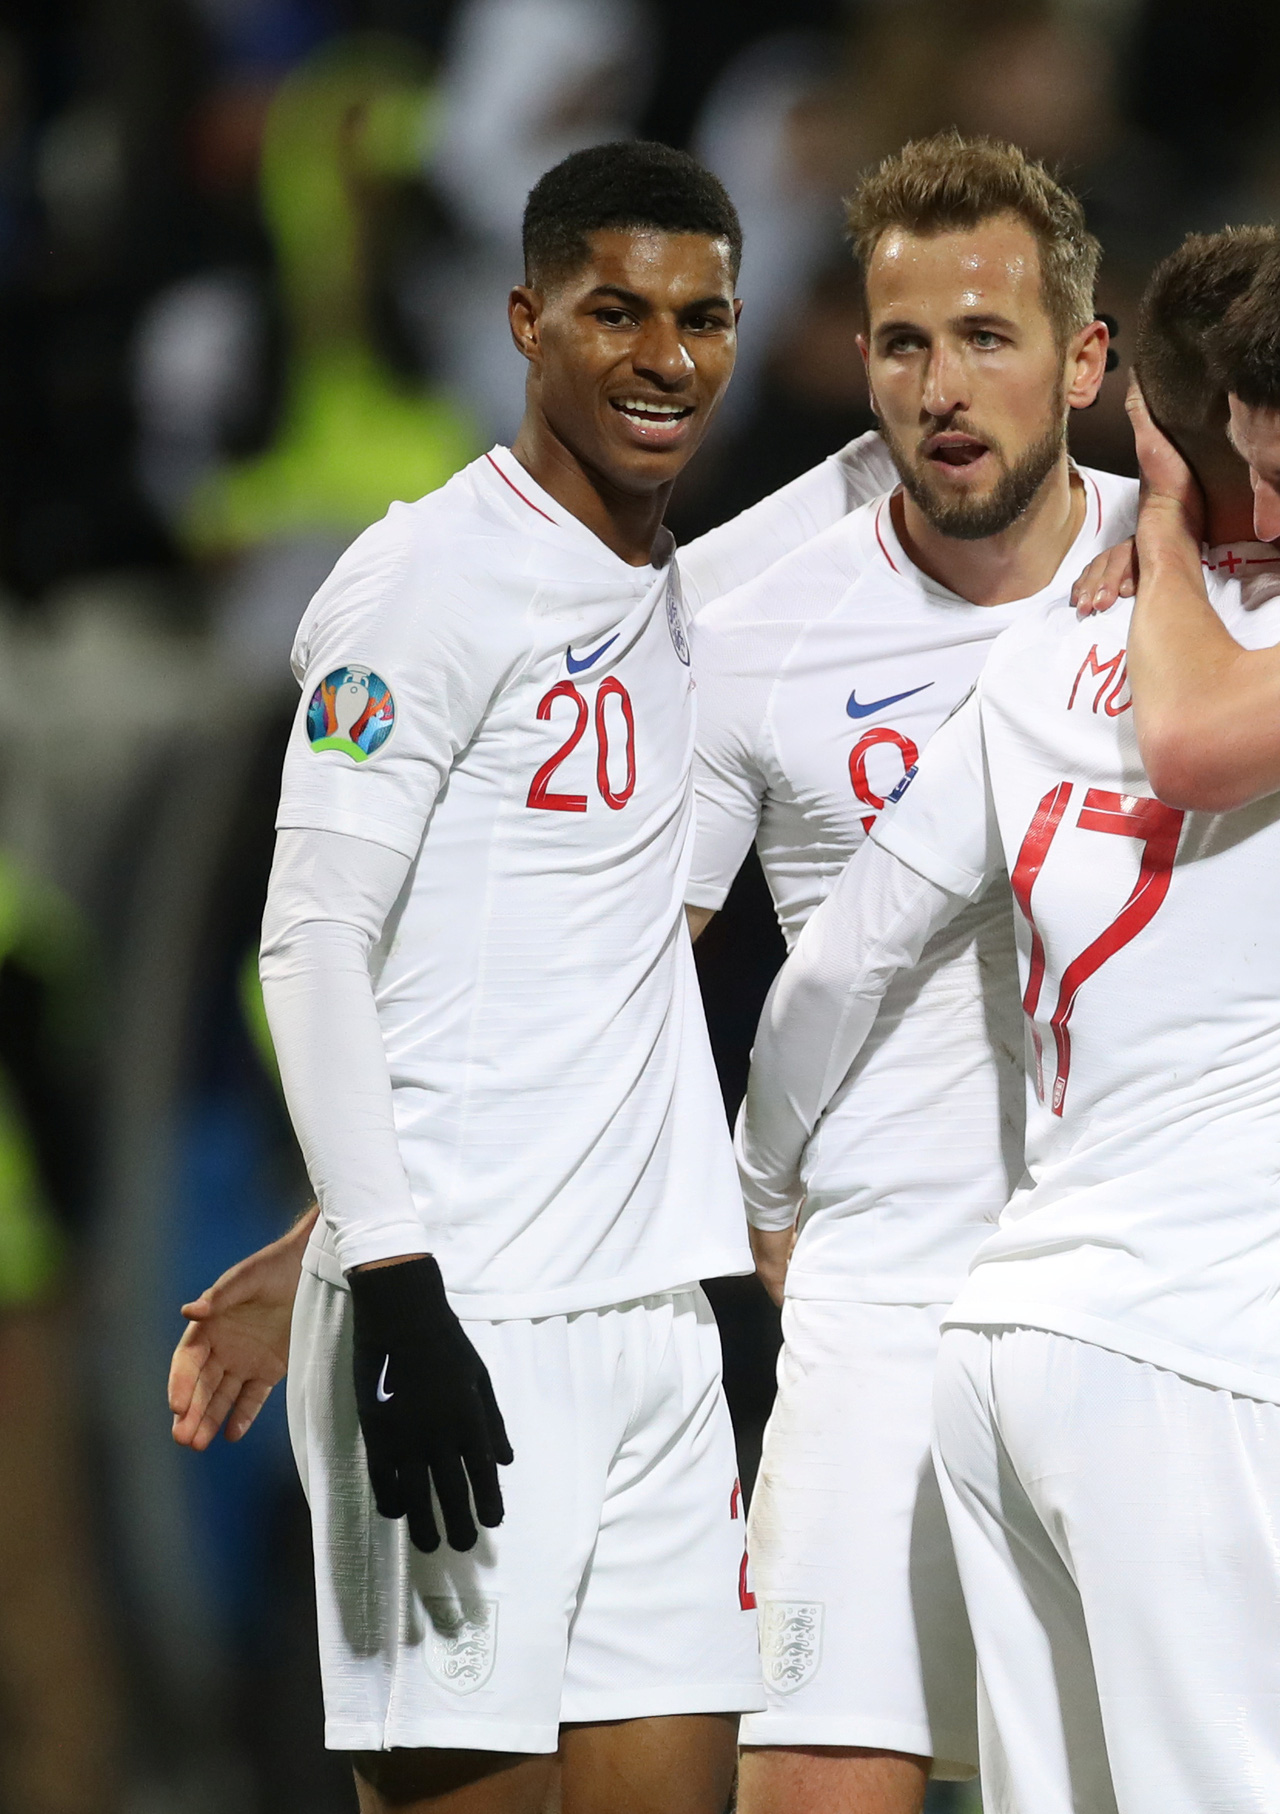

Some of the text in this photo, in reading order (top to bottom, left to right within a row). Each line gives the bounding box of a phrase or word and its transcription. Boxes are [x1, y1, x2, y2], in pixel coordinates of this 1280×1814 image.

[526, 675, 637, 813] 20
[848, 727, 919, 835] 9
[1011, 781, 1185, 1117] 17
